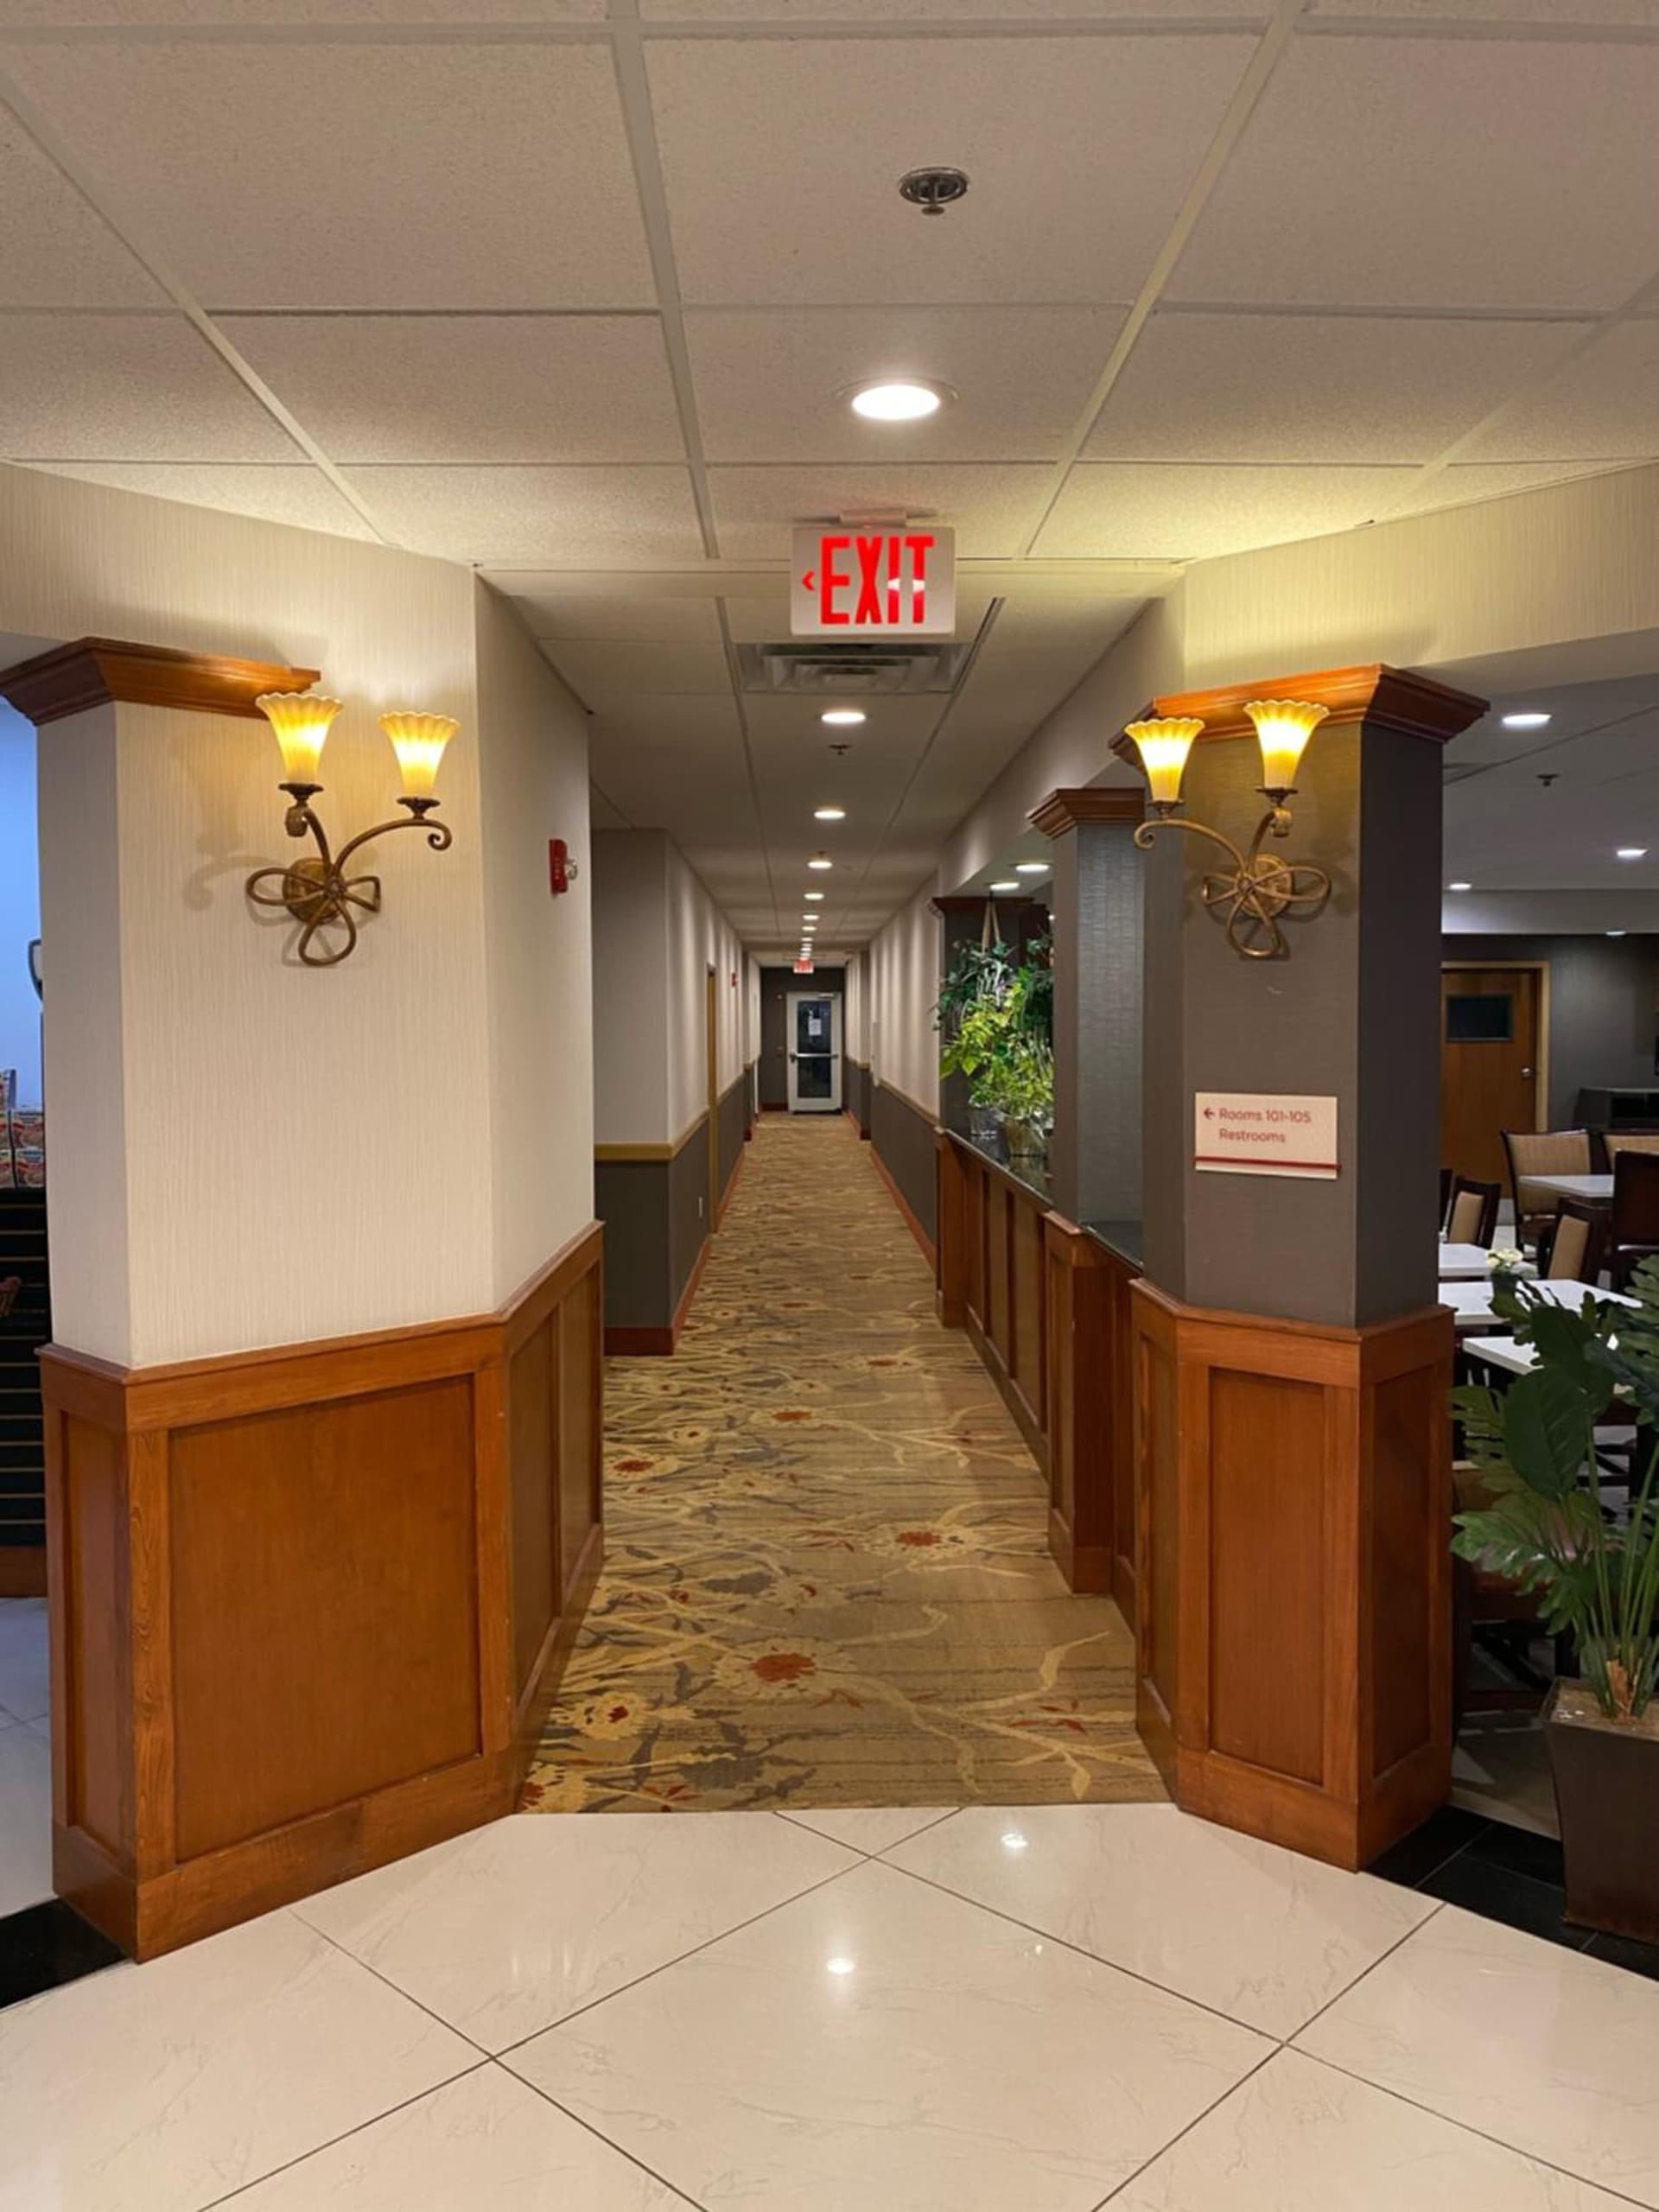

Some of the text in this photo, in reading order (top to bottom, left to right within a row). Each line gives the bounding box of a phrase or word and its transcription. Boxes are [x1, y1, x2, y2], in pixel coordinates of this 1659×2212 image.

[821, 536, 934, 624] EXIT
[1219, 1108, 1312, 1123] Rooms 101-105
[1219, 1128, 1286, 1142] Restrooms
